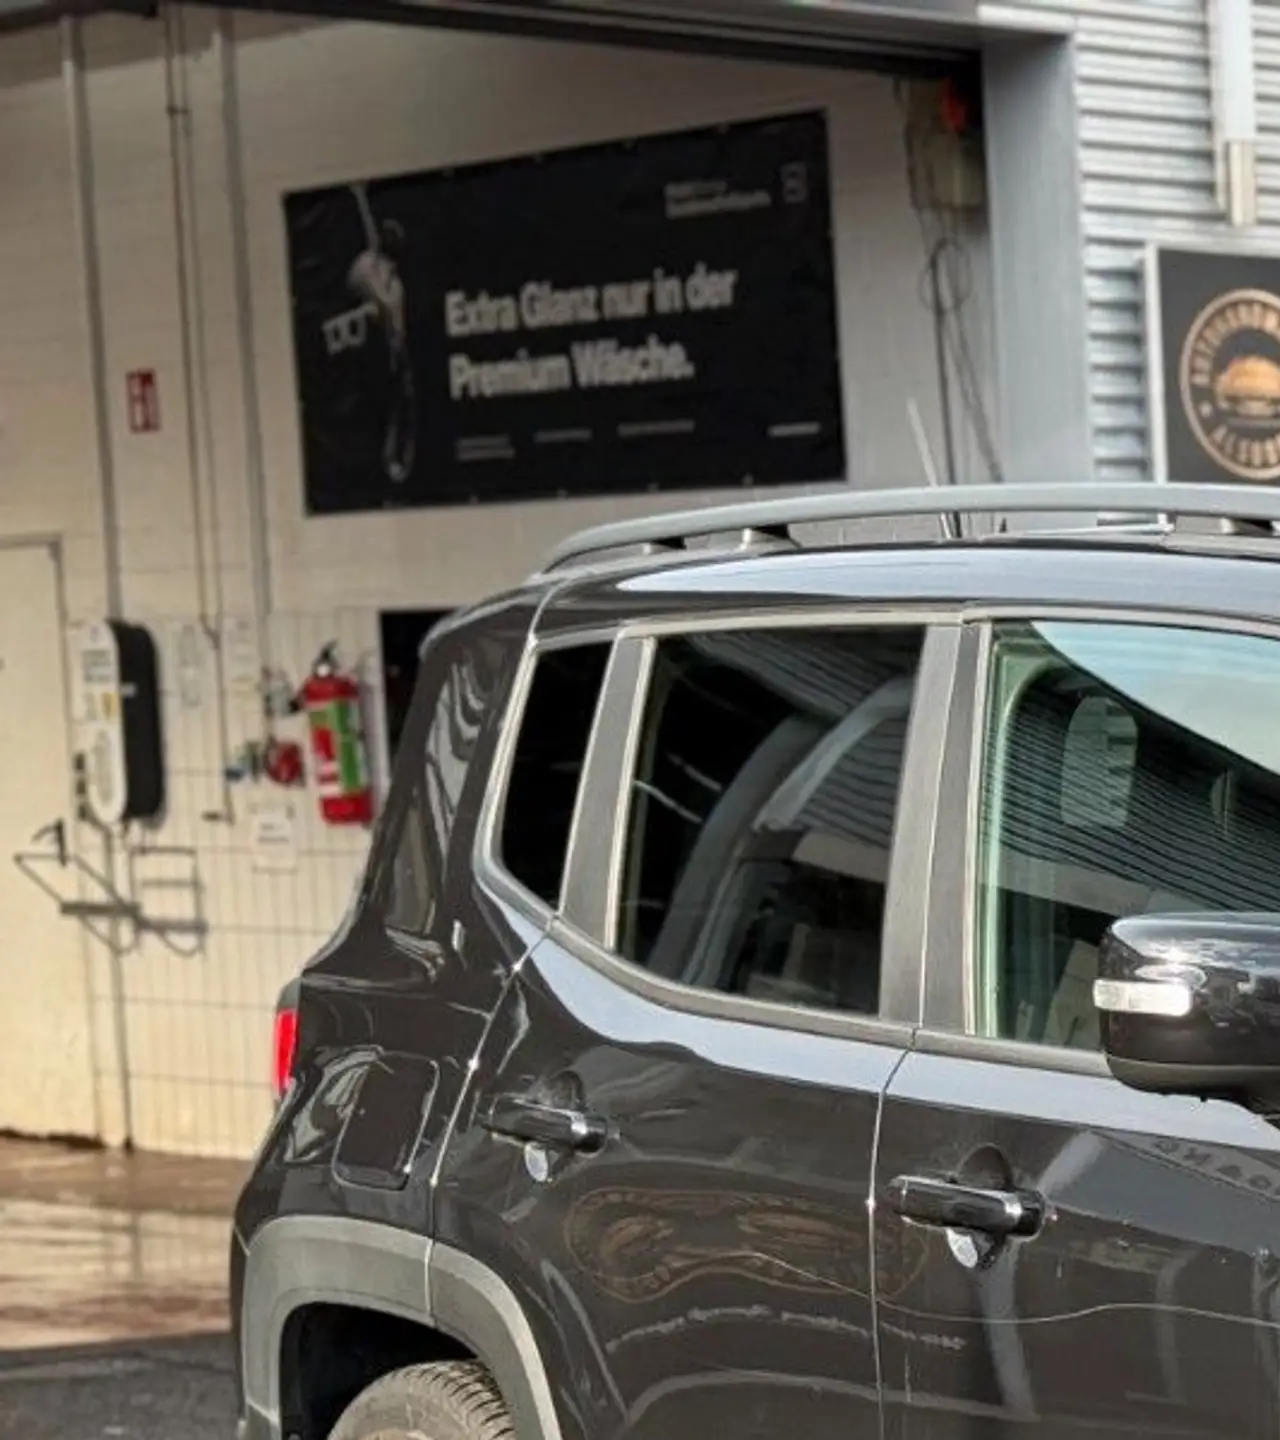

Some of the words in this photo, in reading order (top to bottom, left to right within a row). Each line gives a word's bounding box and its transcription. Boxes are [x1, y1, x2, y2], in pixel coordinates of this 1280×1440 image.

[445, 289, 518, 337] Extra
[520, 280, 601, 328] Glanz
[602, 280, 652, 320] nur
[653, 266, 683, 313] in
[685, 260, 739, 311] der
[449, 347, 571, 400] Premium
[570, 333, 695, 388] Wäsche.
